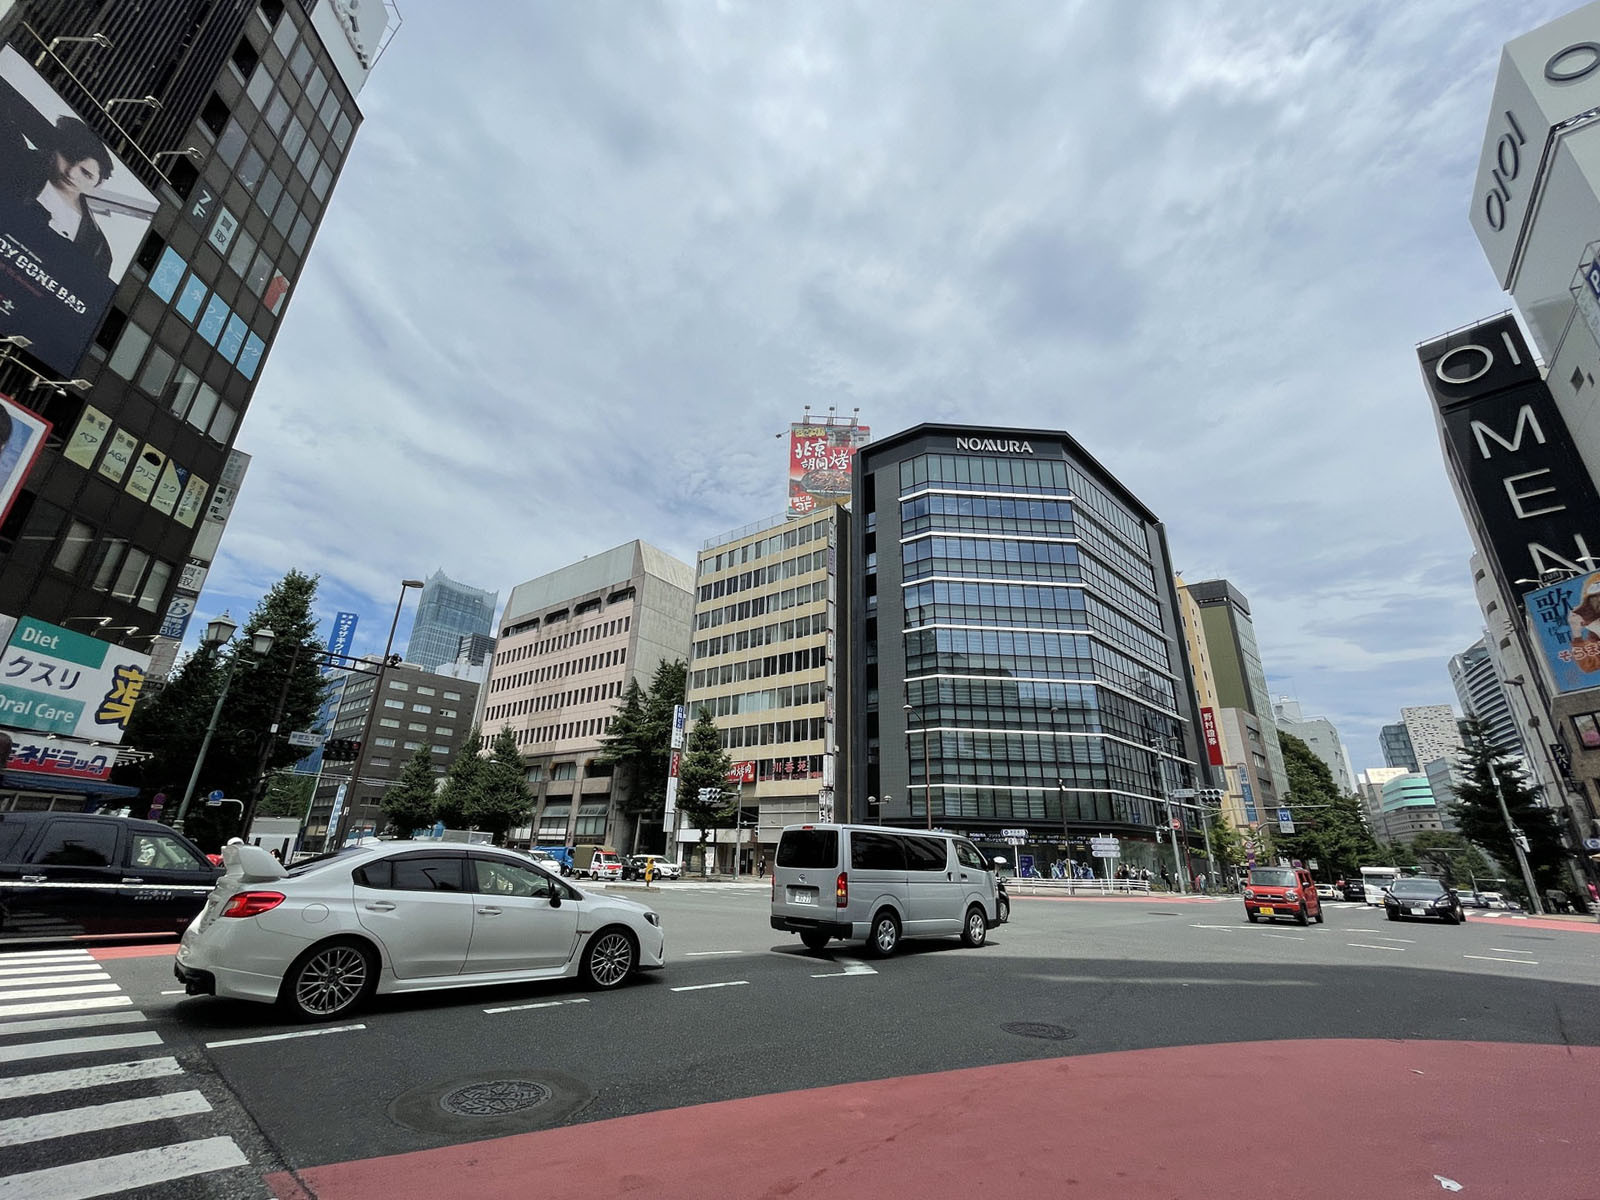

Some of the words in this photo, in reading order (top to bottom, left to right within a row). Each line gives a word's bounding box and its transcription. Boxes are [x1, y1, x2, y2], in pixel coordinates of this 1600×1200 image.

[192, 190, 212, 218] 7F
[795, 438, 827, 459] 北京
[956, 437, 1034, 454] NOMURA
[108, 449, 127, 465] AGA
[21, 627, 60, 650] Diet
[5, 655, 81, 691] クスリ
[35, 703, 75, 723] Care
